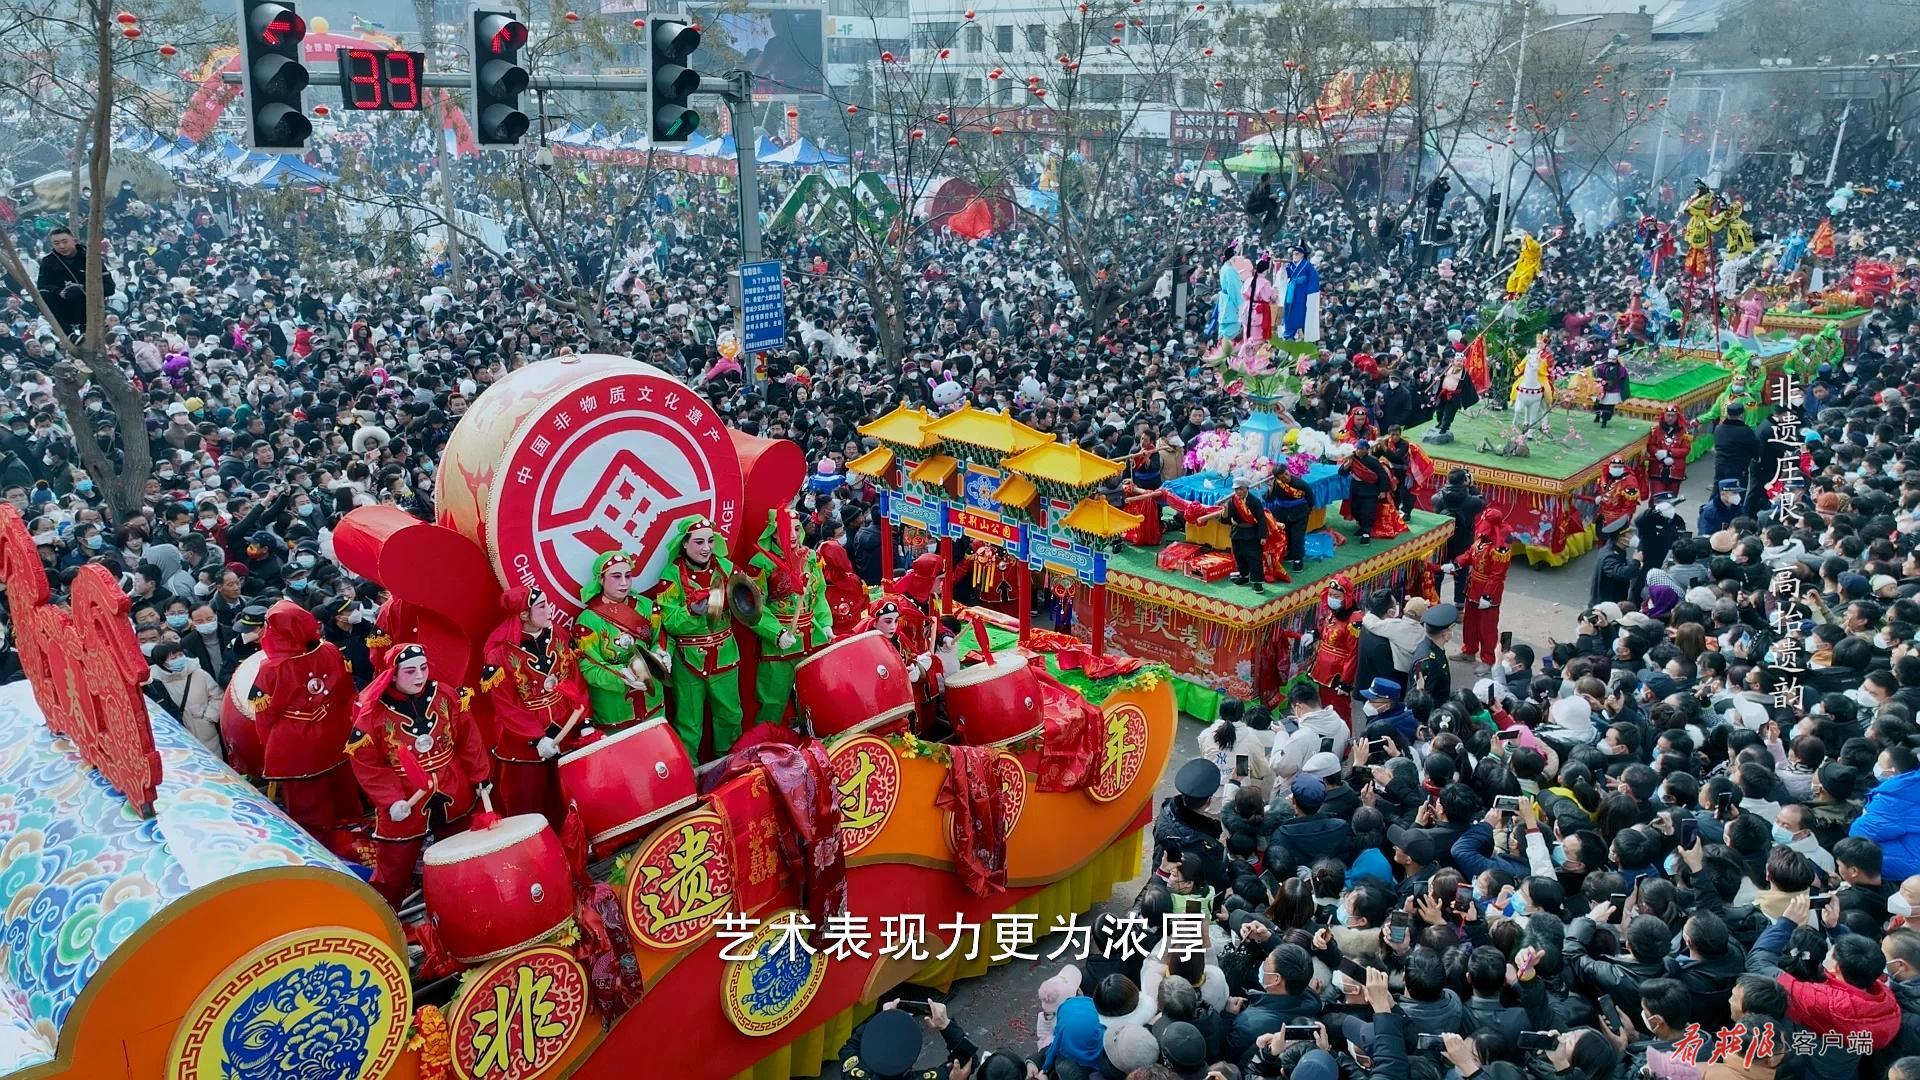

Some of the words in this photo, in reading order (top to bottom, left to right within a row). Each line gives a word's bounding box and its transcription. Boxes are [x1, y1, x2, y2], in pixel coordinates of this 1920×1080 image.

[348, 51, 418, 110] 33
[516, 384, 721, 486] 中国非物质文化遗产
[957, 512, 1011, 539] 紫荆山公园
[832, 751, 886, 829] 过
[1100, 713, 1137, 791] 年
[639, 825, 732, 934] 遗
[472, 967, 566, 1078] 非
